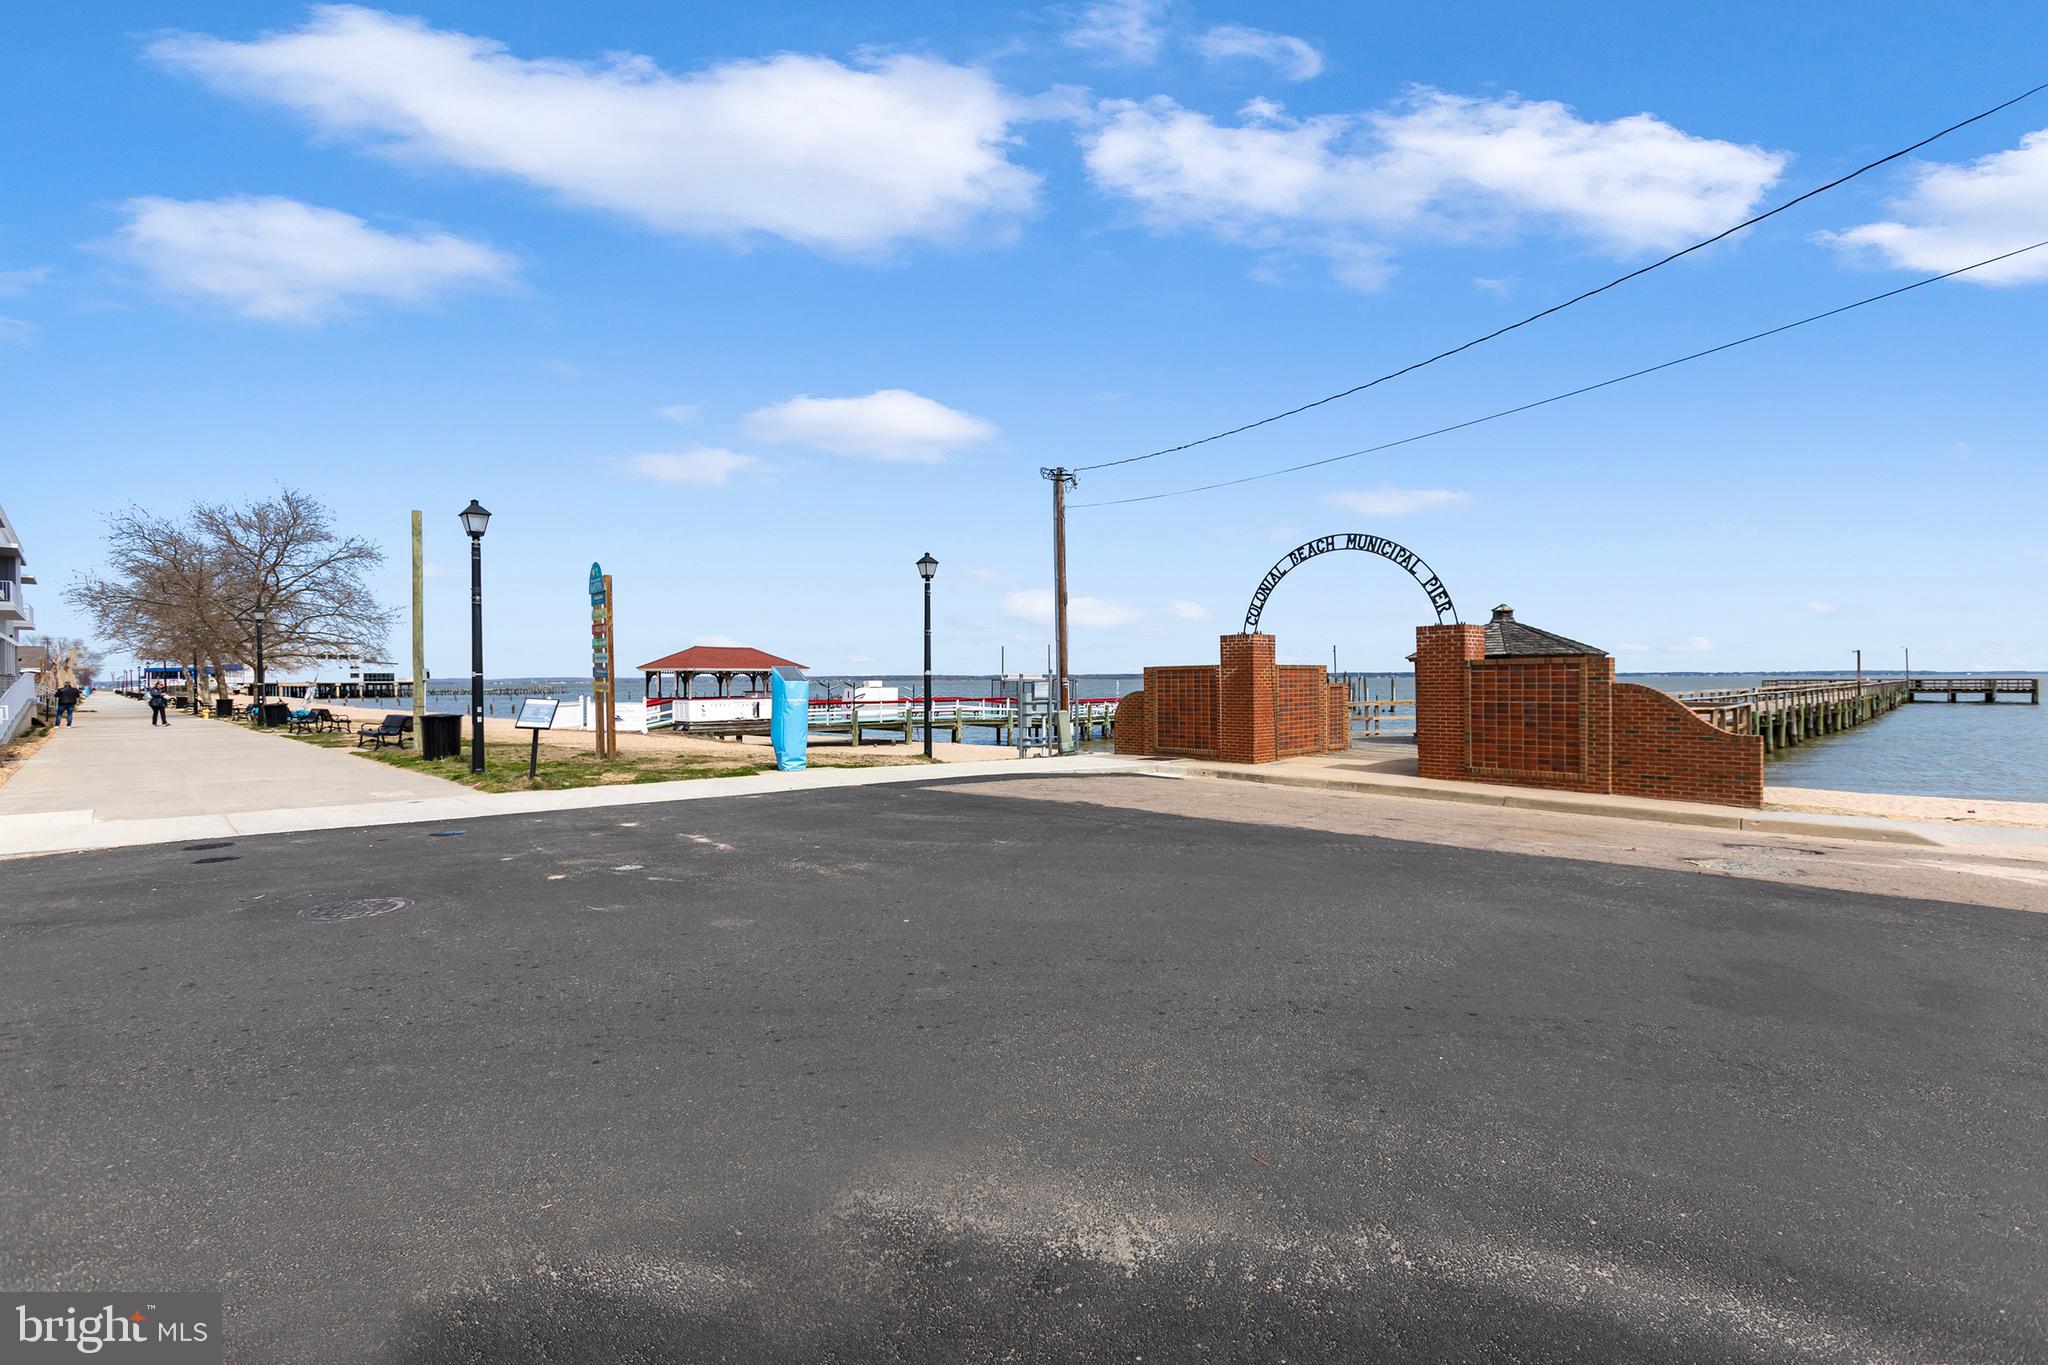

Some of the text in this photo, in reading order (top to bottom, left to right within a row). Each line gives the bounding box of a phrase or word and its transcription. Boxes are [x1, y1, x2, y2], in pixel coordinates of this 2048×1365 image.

[1246, 534, 1453, 627] COLONIAL BEACH MUNICIPAL PIER
